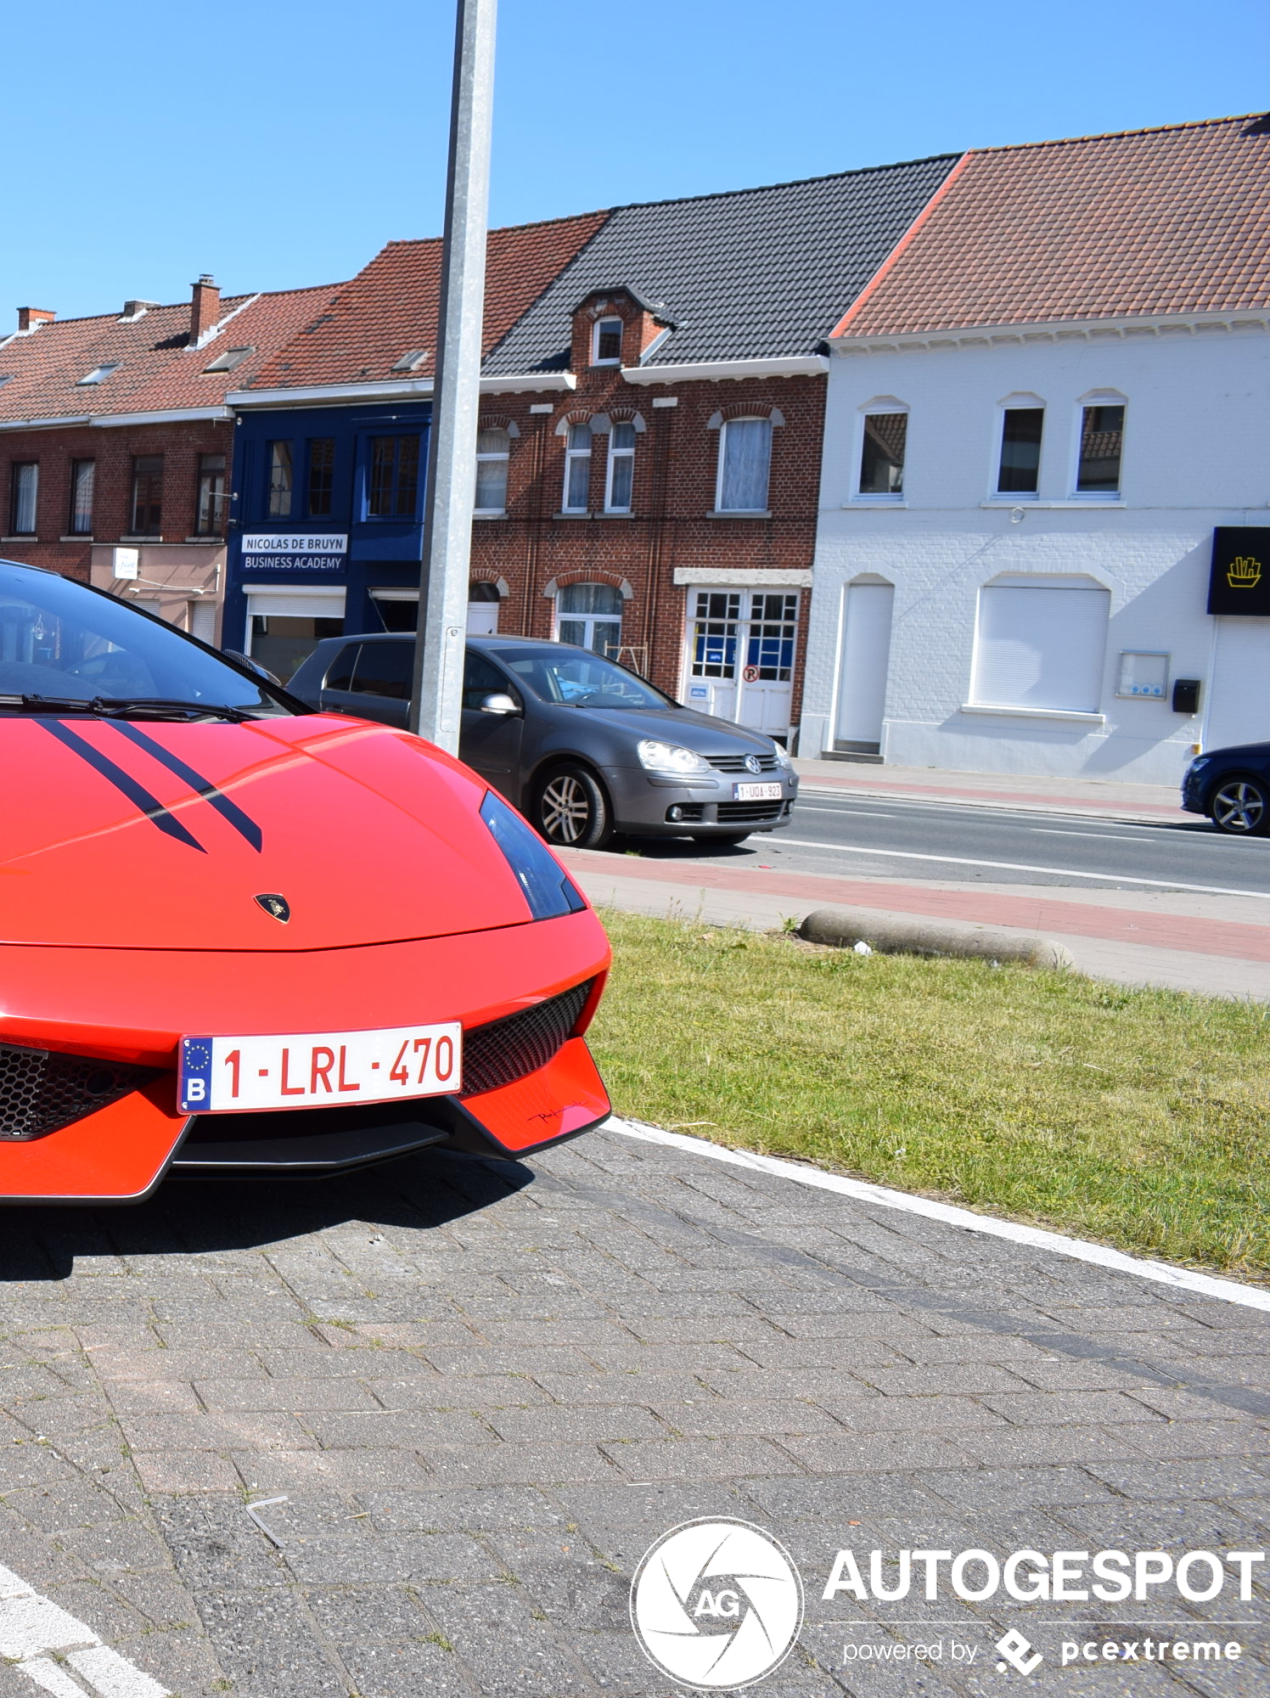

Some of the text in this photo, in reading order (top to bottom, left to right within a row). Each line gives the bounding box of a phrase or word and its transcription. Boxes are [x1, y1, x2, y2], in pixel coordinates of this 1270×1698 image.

[246, 538, 343, 550] NICOLAS DE BRUYN
[245, 556, 342, 569] BUSINESS ACADEMY
[224, 1035, 454, 1098] 1-LRL-470
[187, 1078, 206, 1101] B
